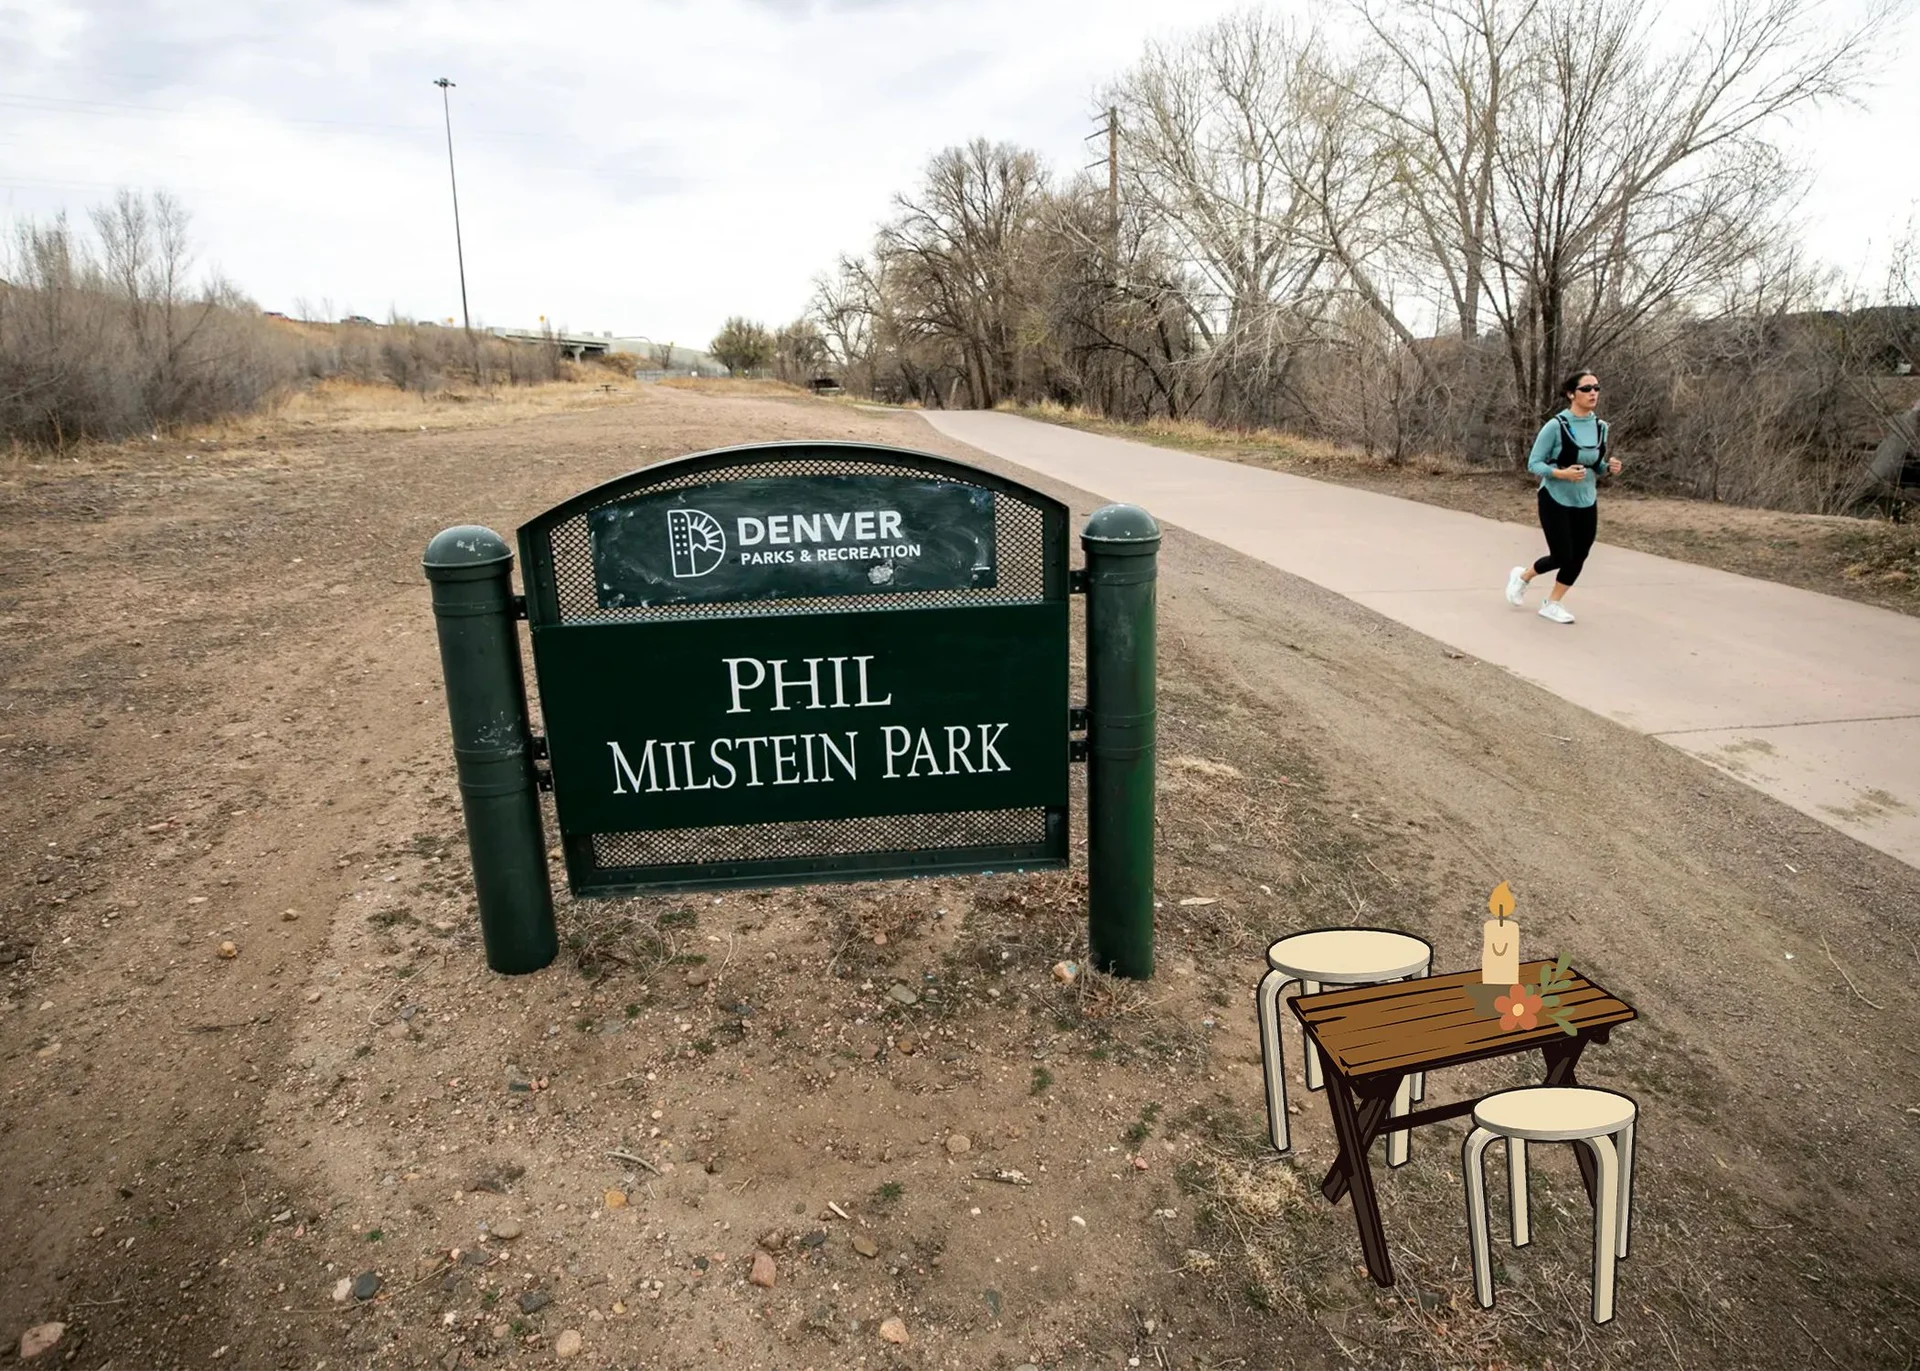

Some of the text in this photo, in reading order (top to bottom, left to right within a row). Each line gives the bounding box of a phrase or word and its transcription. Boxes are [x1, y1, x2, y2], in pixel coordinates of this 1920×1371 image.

[736, 510, 905, 546] DENVER
[740, 544, 922, 566] PARKS & RECREATION
[721, 655, 893, 714] PHIL
[606, 722, 1012, 794] MILSTEIN PARK
